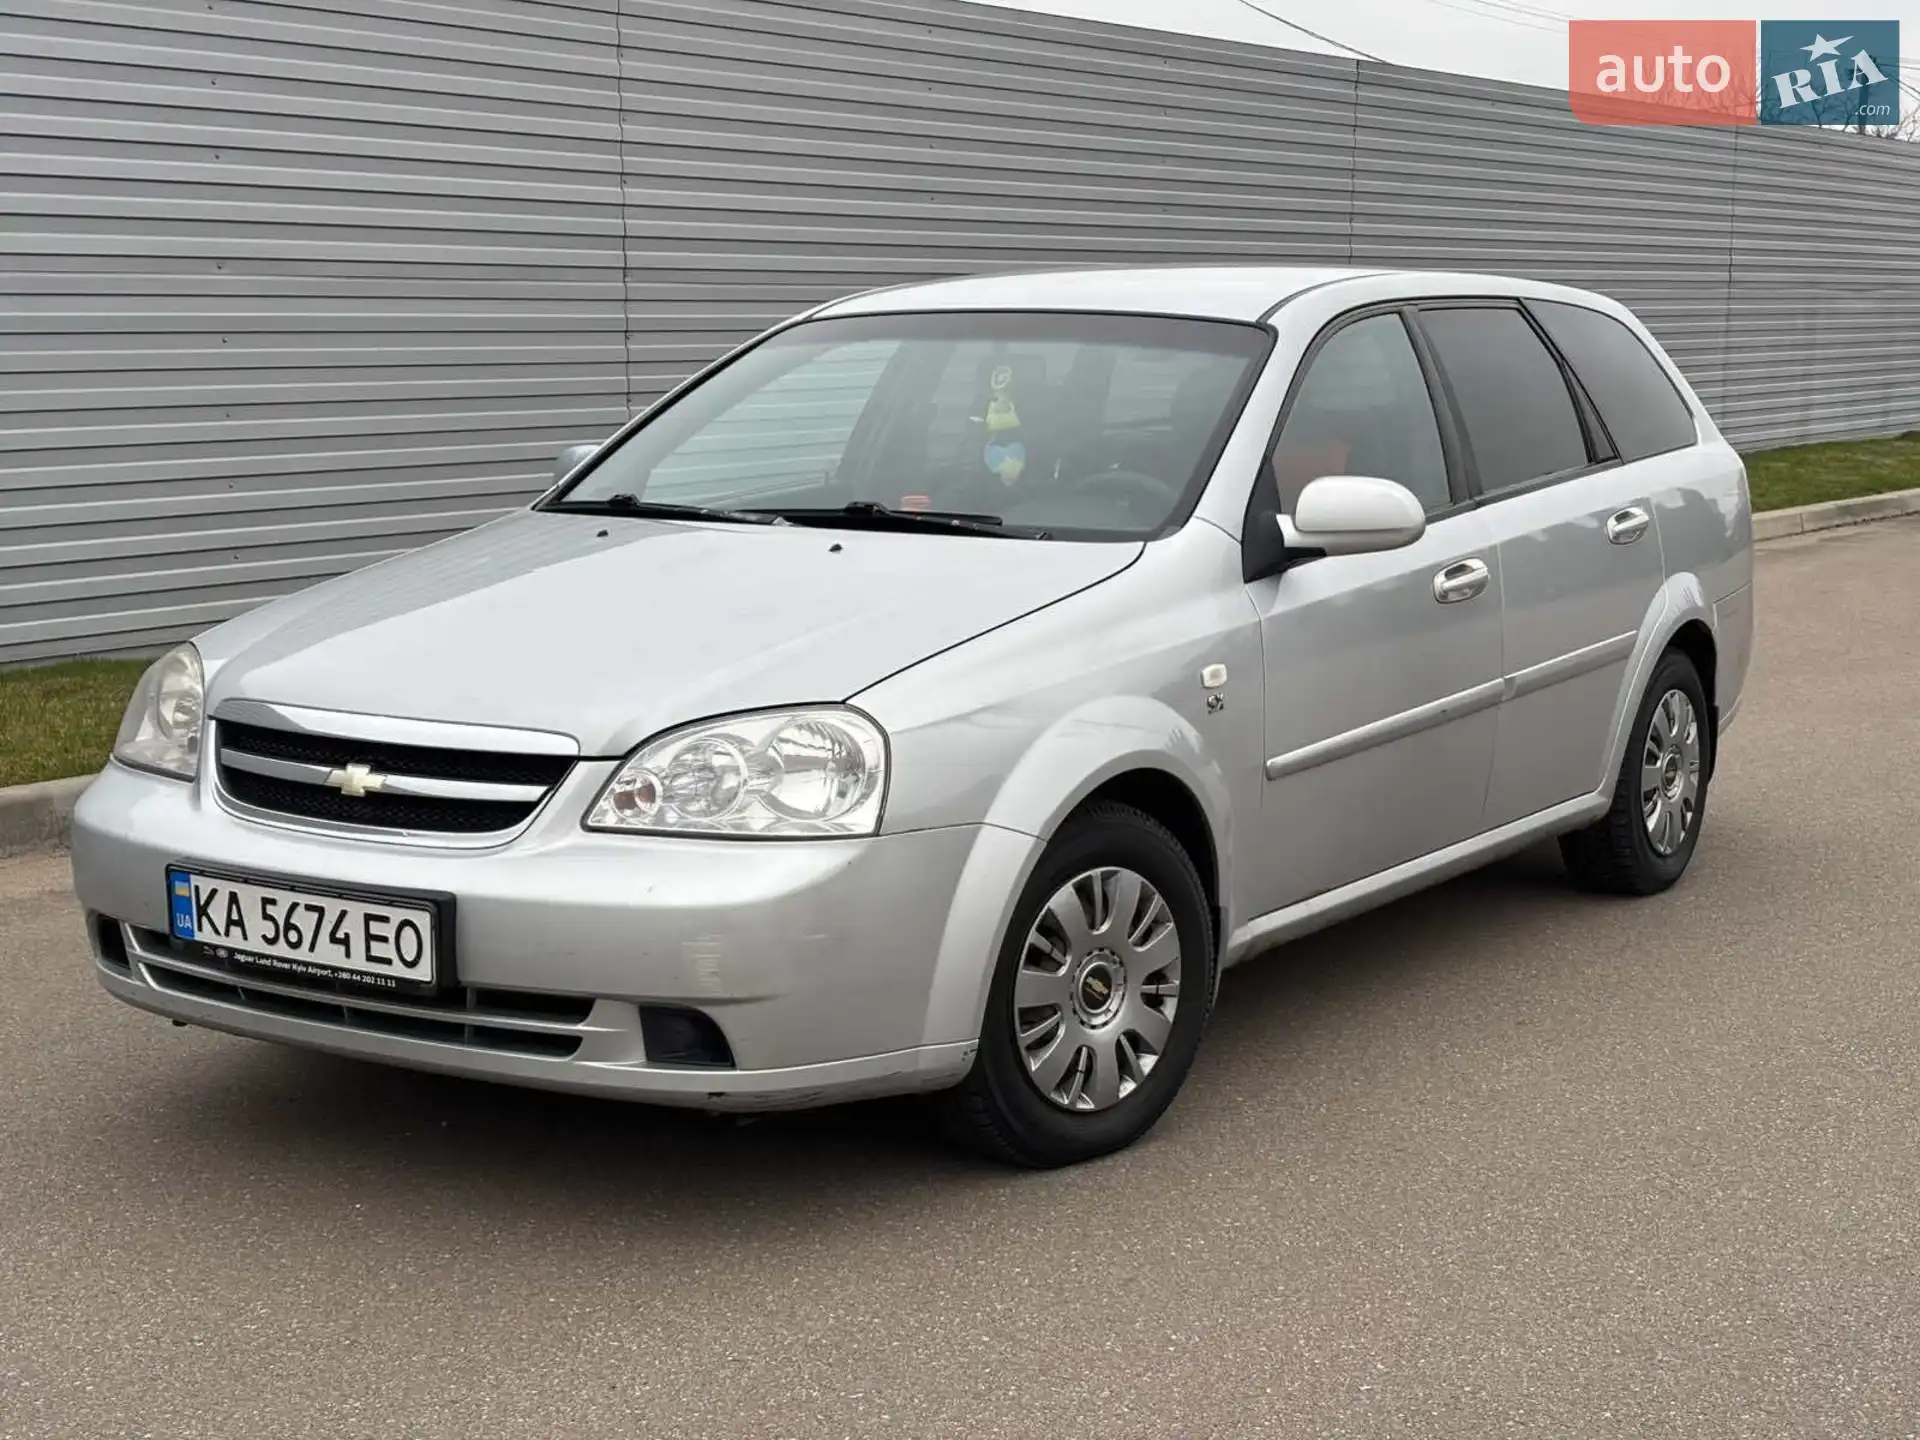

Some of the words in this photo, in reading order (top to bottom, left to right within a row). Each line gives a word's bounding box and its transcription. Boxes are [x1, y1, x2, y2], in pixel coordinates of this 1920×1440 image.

[176, 912, 192, 930] UA
[193, 884, 248, 941] KA
[260, 896, 351, 960] 5674
[363, 912, 423, 969] EO
[255, 956, 271, 966] Land
